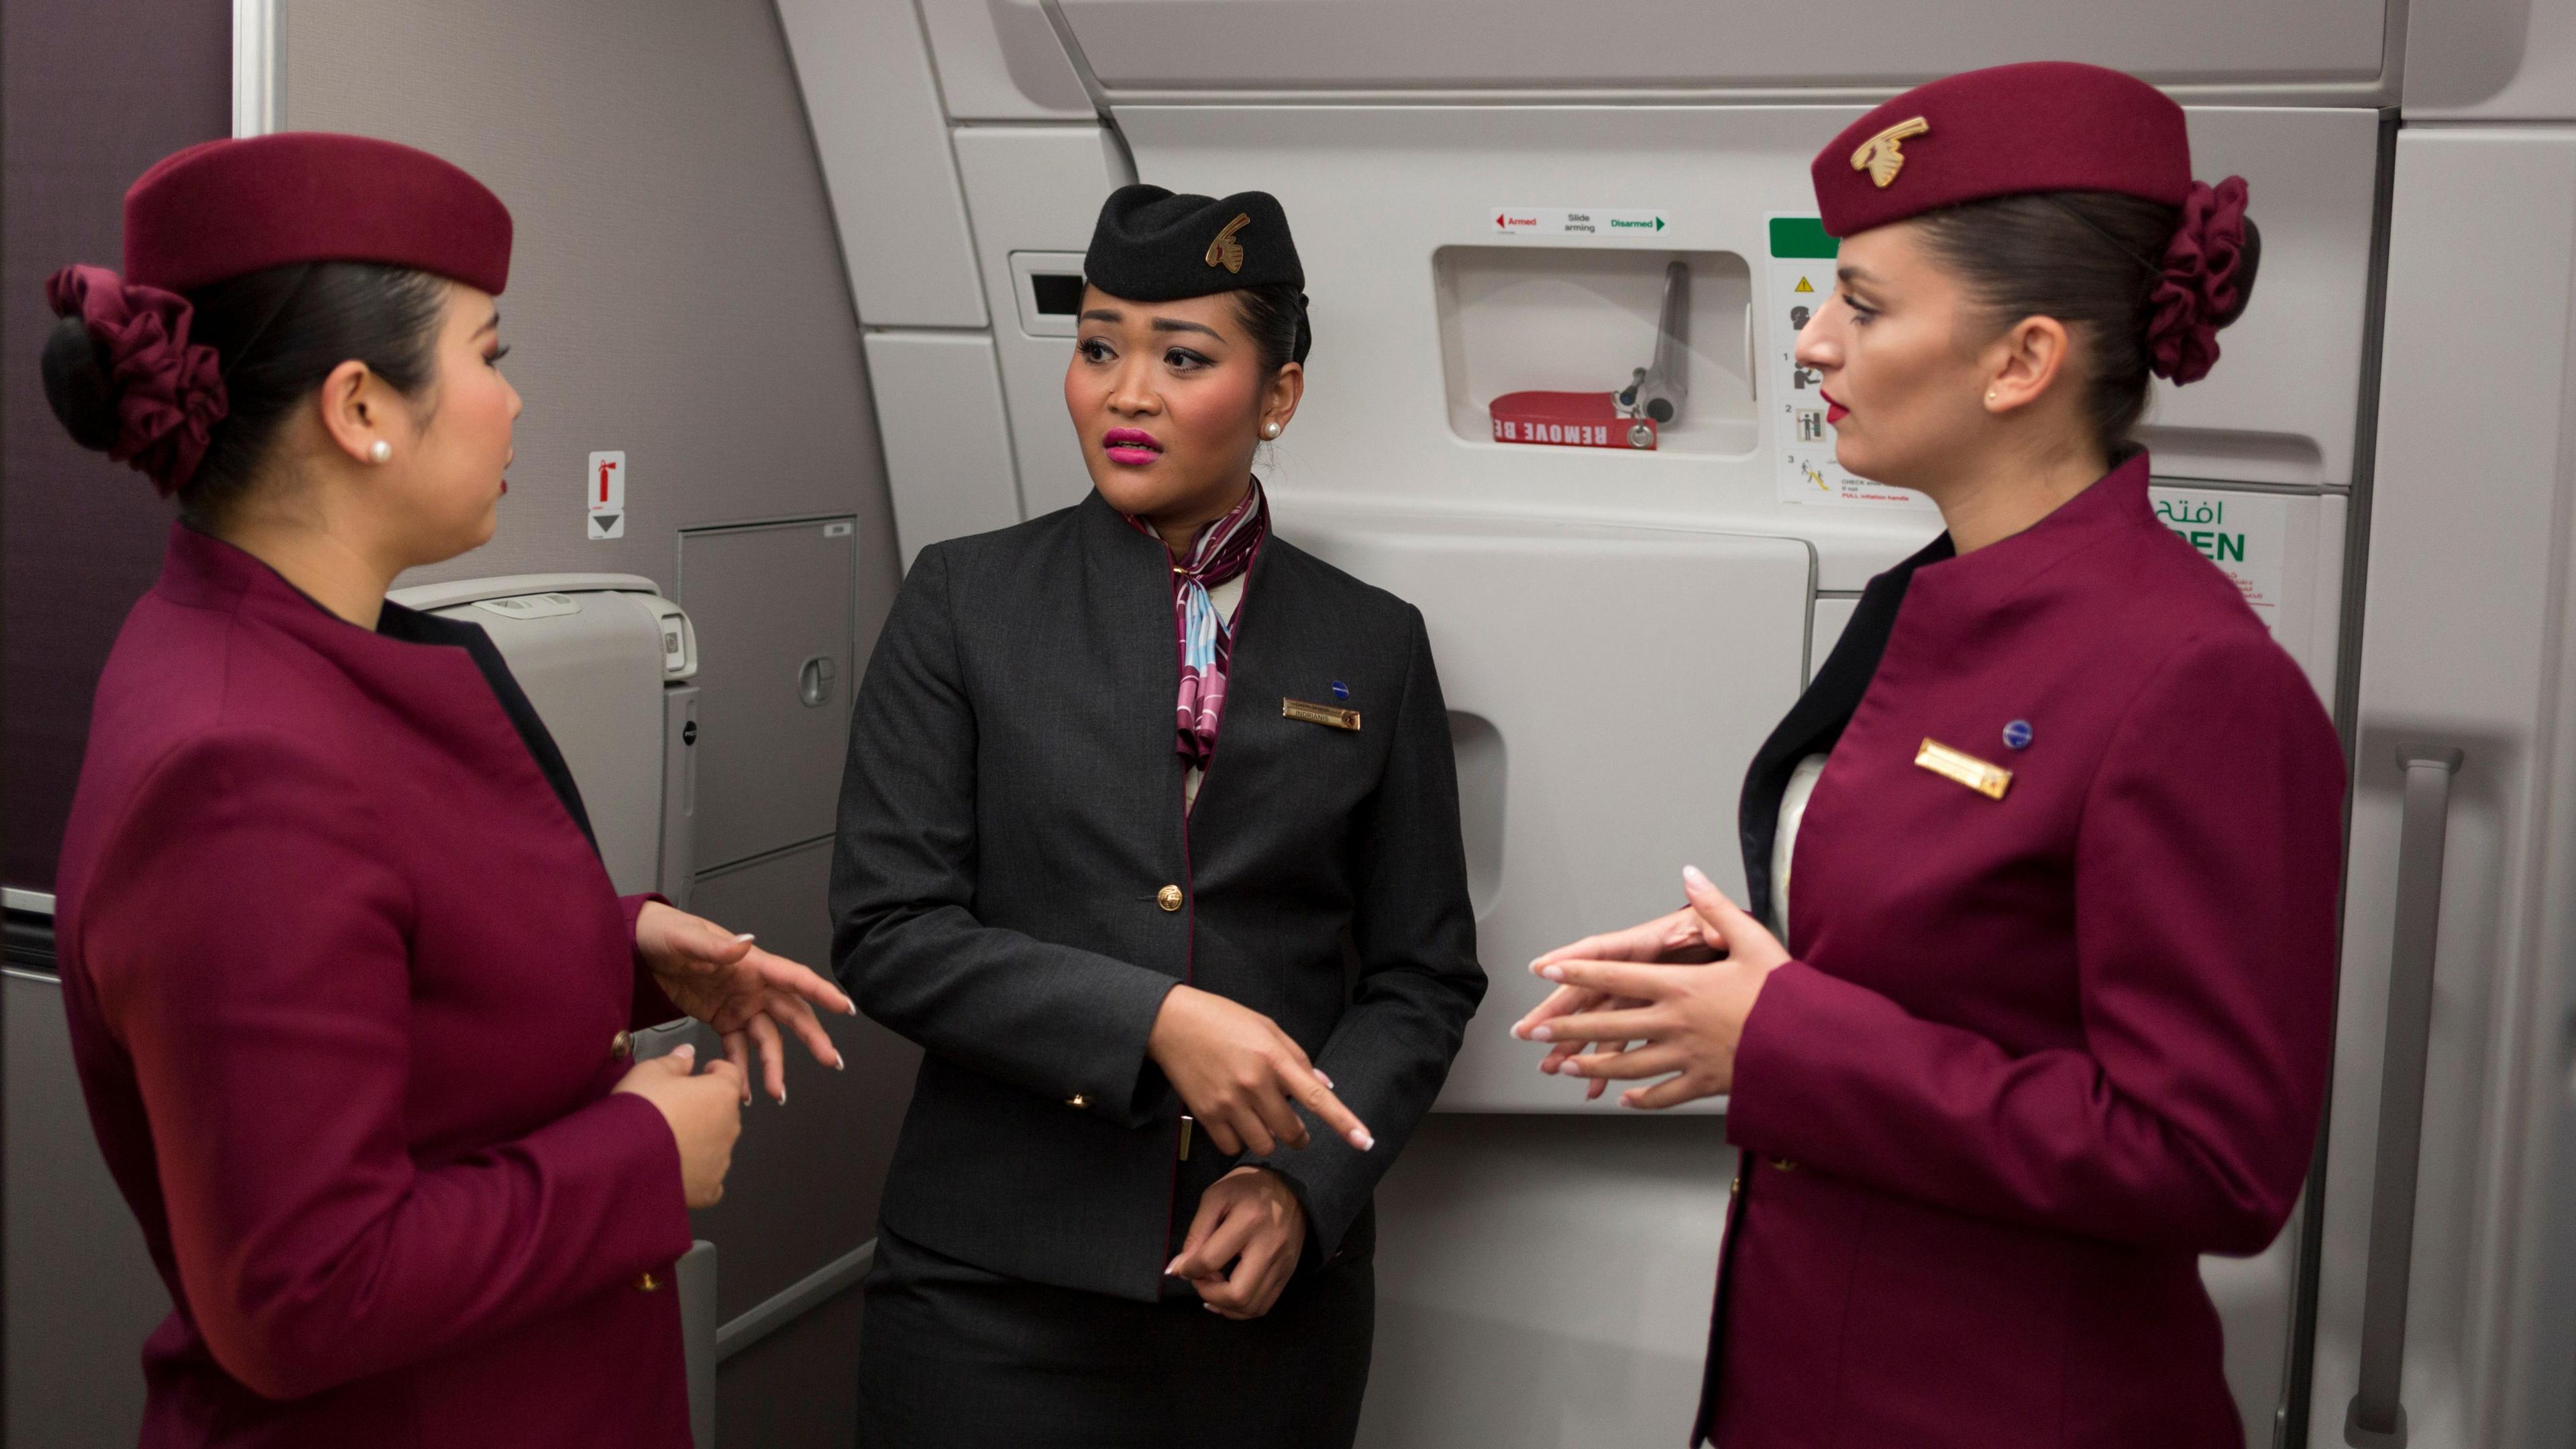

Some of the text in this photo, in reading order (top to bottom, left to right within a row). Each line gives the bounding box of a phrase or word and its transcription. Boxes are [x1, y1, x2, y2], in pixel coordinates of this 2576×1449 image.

[1508, 218, 1537, 226] Armed
[1568, 213, 1591, 222] Slide
[1611, 219, 1654, 227] Disarmed
[1564, 224, 1596, 233] arming
[1785, 405, 1792, 413] 2
[1523, 422, 1607, 445] REMOVE
[1787, 455, 1794, 464] 3
[1295, 710, 1330, 722] INDRIANIS
